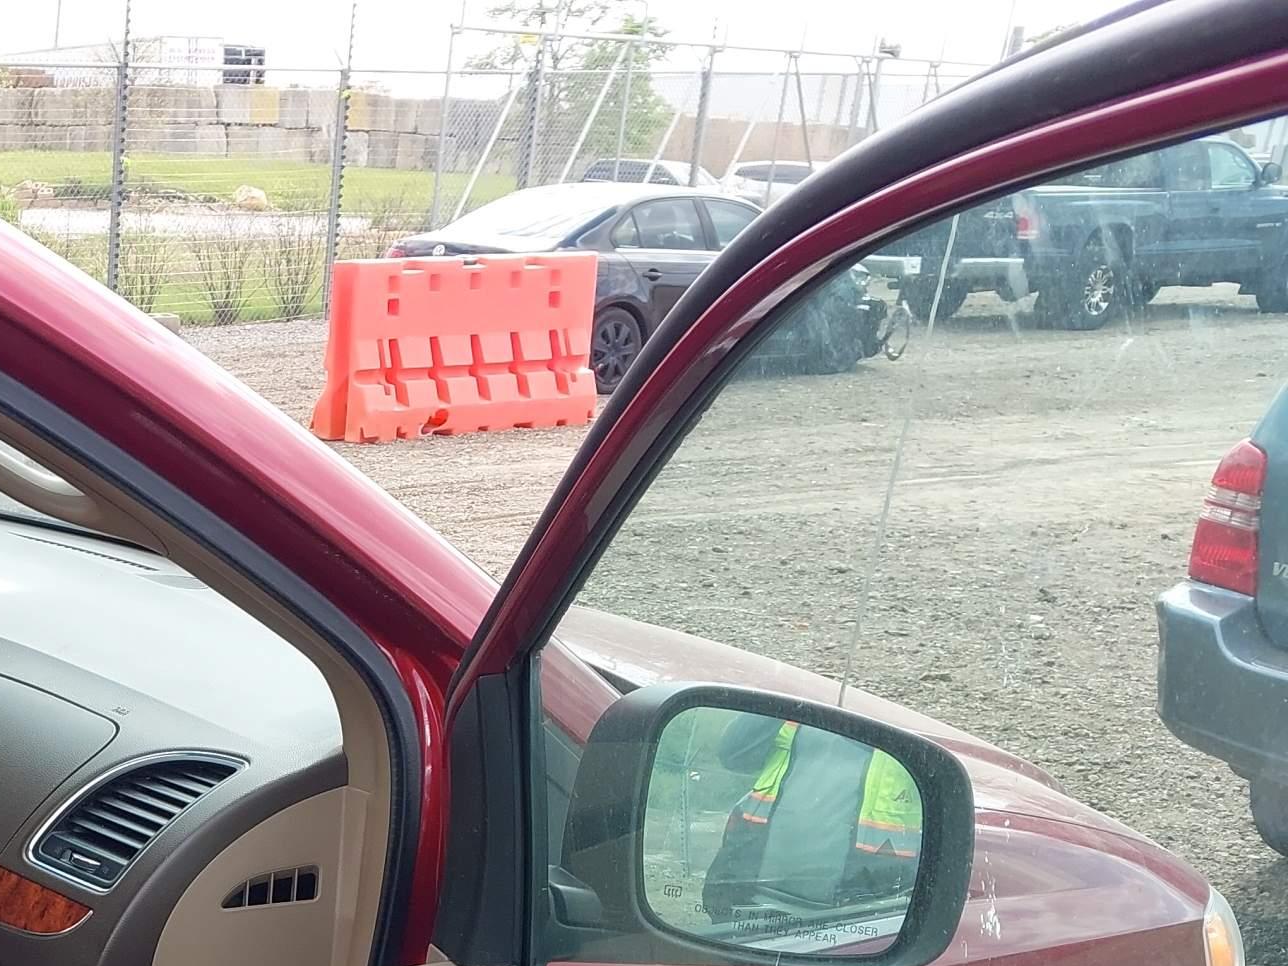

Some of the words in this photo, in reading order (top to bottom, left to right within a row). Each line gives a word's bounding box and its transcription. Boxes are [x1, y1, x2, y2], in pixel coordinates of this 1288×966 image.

[732, 921, 759, 932] THAN
[764, 924, 790, 936] THEY
[794, 929, 838, 945] APPEAR
[835, 922, 879, 937] CLOSER
